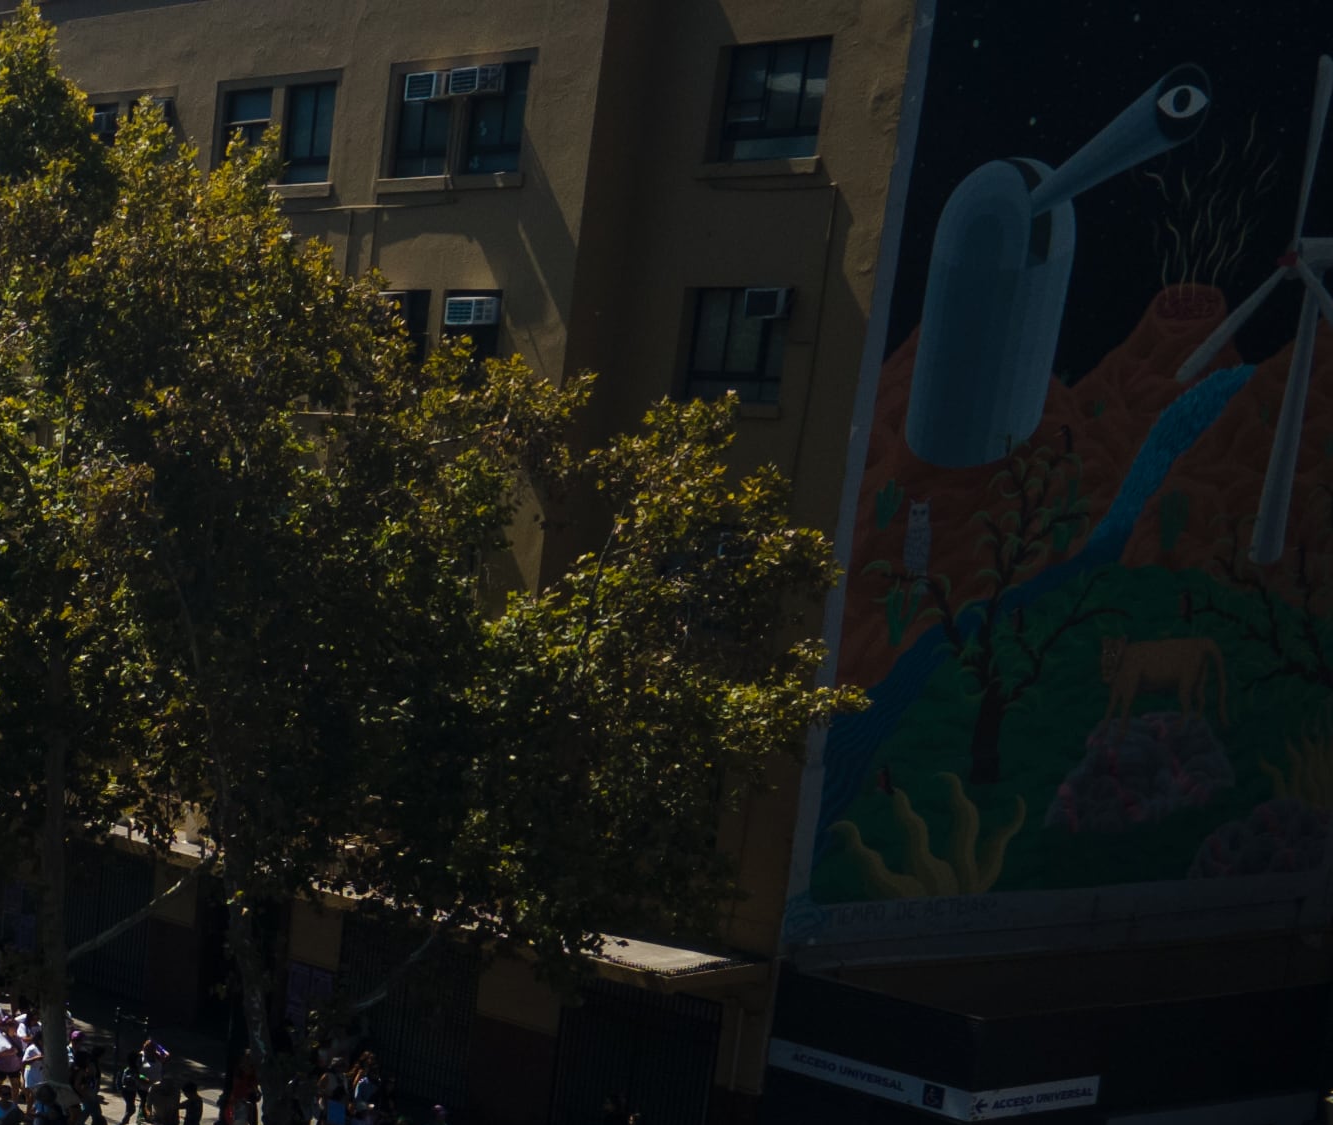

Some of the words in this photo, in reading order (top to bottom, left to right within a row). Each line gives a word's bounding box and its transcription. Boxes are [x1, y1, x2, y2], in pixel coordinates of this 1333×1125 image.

[791, 1052, 836, 1073] ACCESO
[839, 1065, 905, 1092] UNIVERSAL
[991, 1096, 1033, 1111] ACCESO
[1036, 1087, 1094, 1104] UNIVERSAL
